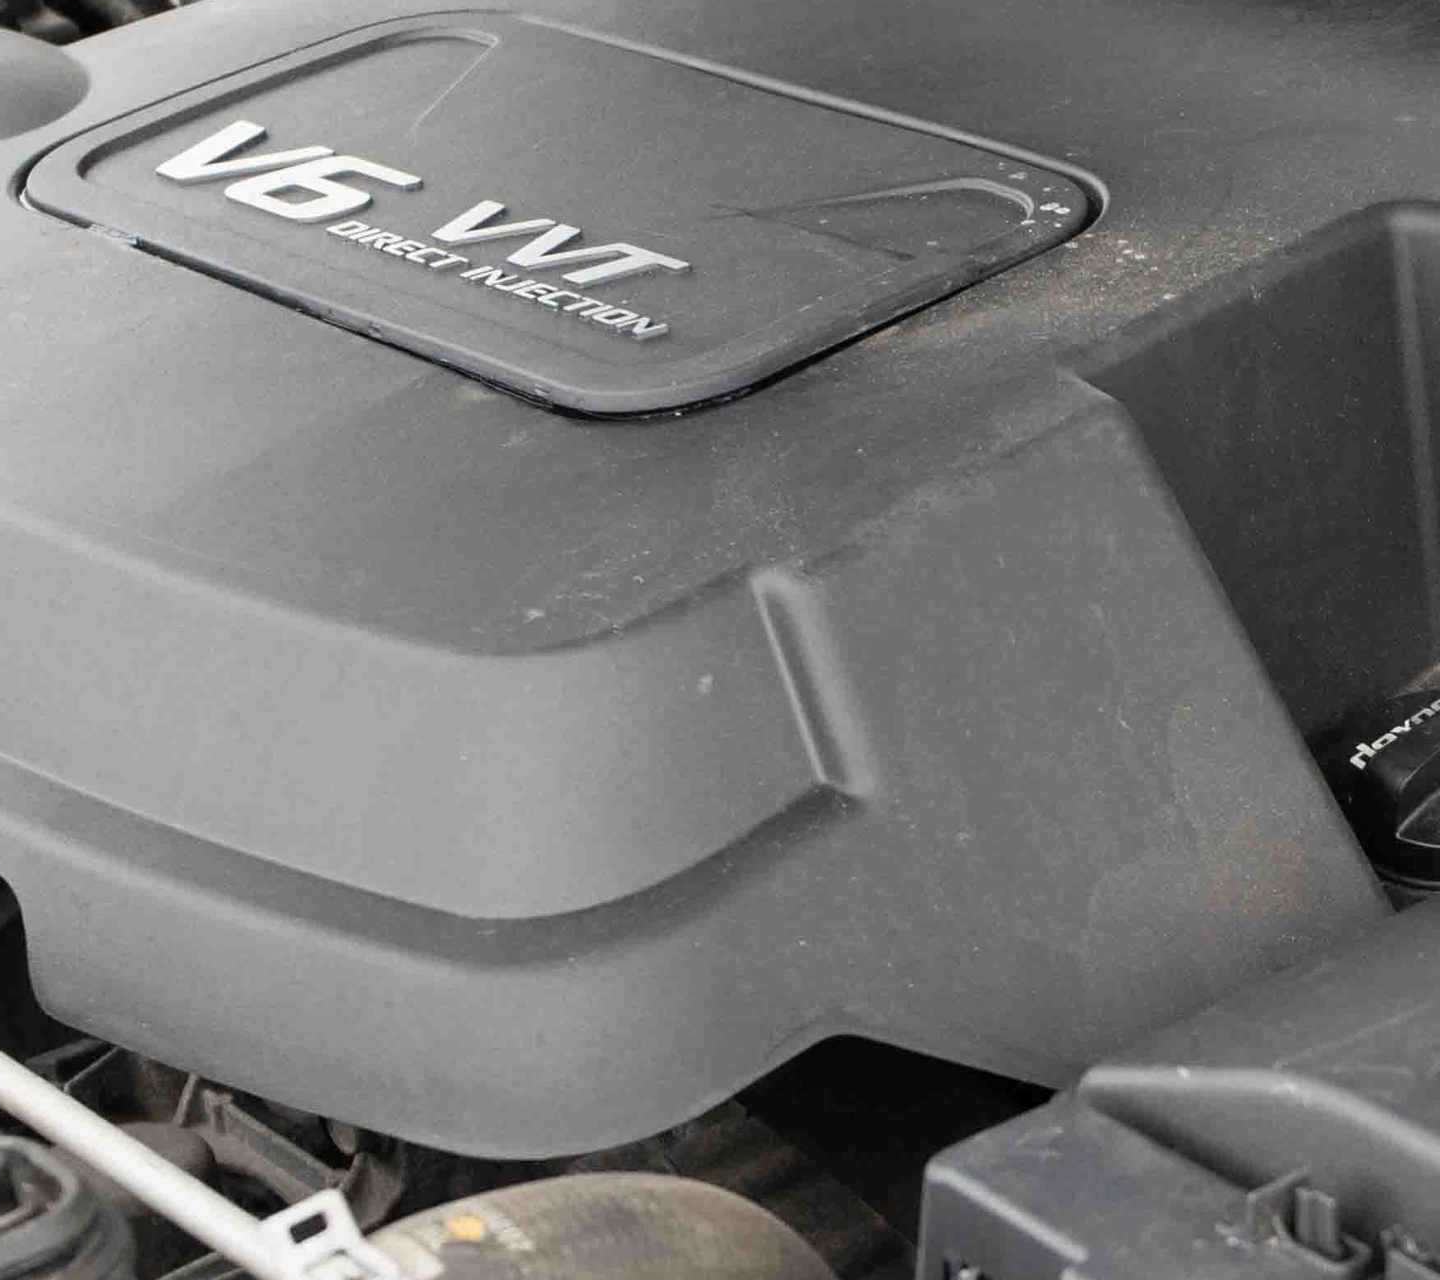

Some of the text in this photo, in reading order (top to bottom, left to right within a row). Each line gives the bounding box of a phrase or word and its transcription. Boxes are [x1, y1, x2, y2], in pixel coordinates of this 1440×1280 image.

[155, 119, 692, 288] V6 VVT
[326, 220, 669, 340] DIRECT INJECTION
